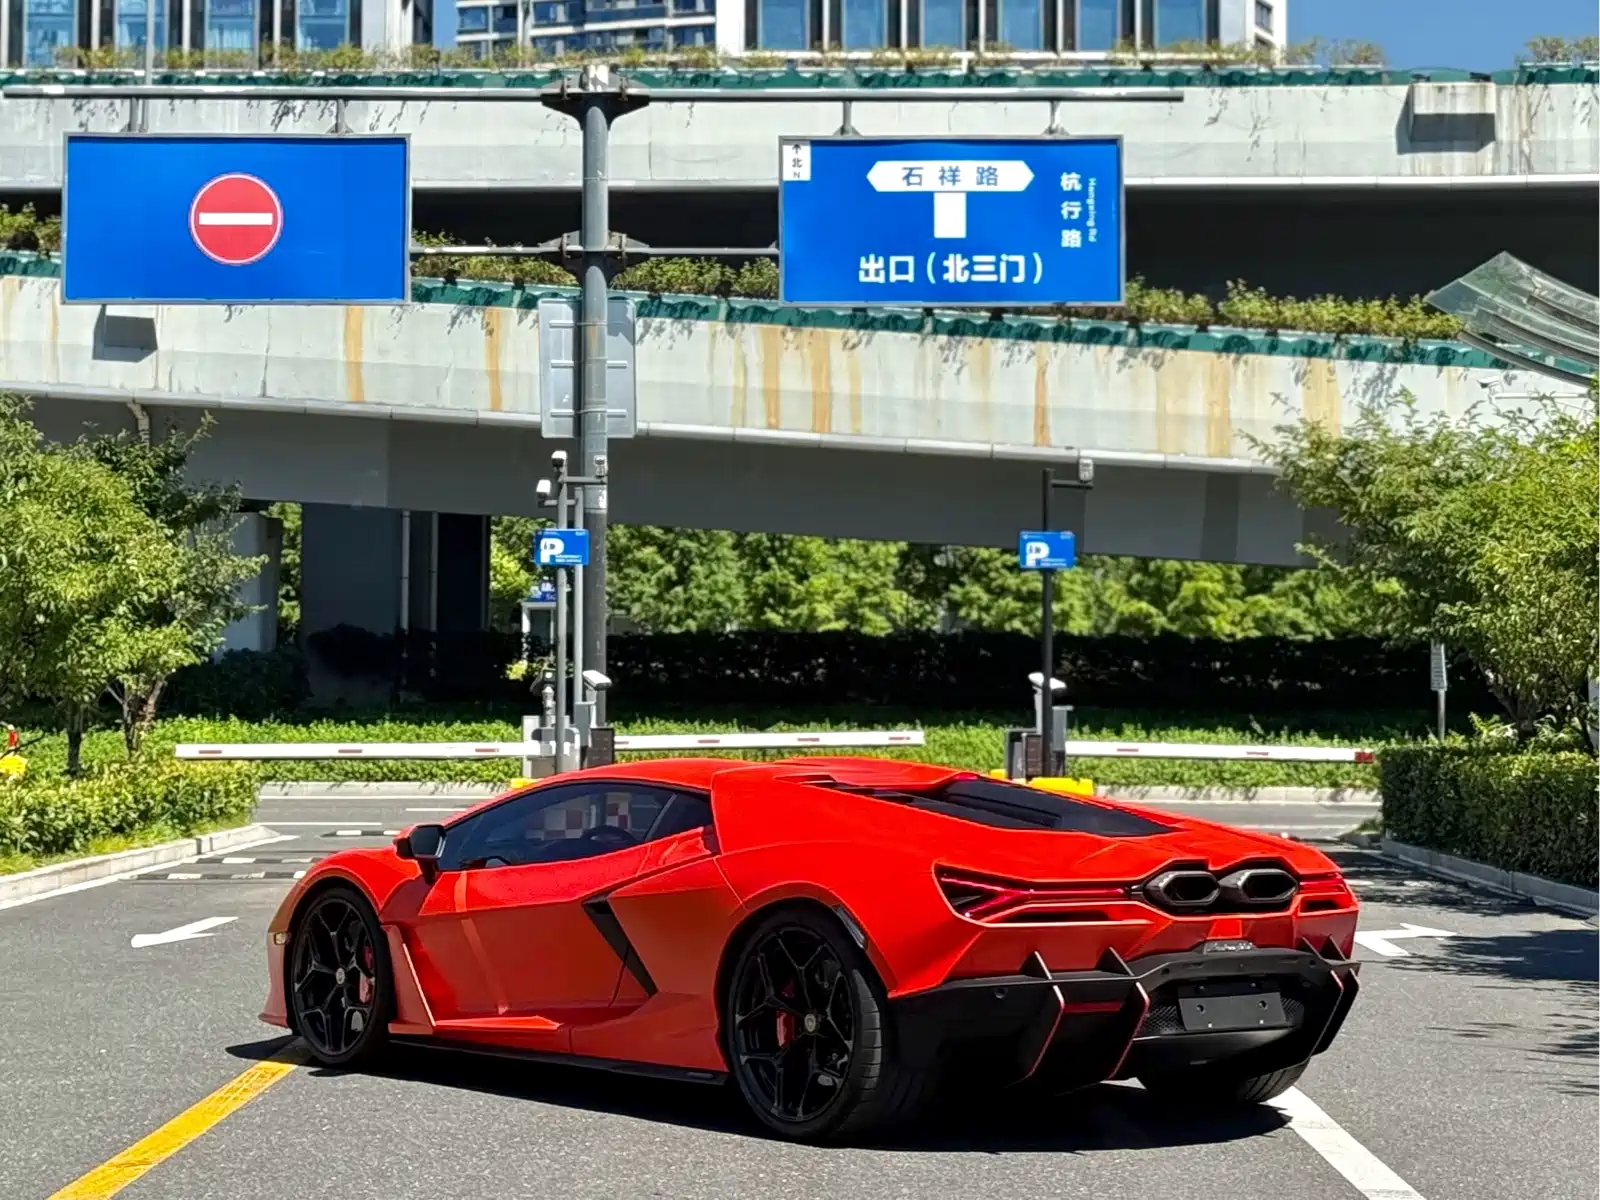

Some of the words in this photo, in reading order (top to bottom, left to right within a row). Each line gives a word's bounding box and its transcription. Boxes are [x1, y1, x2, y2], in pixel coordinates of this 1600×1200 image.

[792, 157, 803, 168] 北
[793, 171, 801, 179] N
[902, 165, 999, 187] 石祥路
[1060, 171, 1083, 249] 杭行路
[858, 251, 1043, 285] 出口（北三门）
[540, 537, 565, 564] P
[1026, 541, 1050, 568] P
